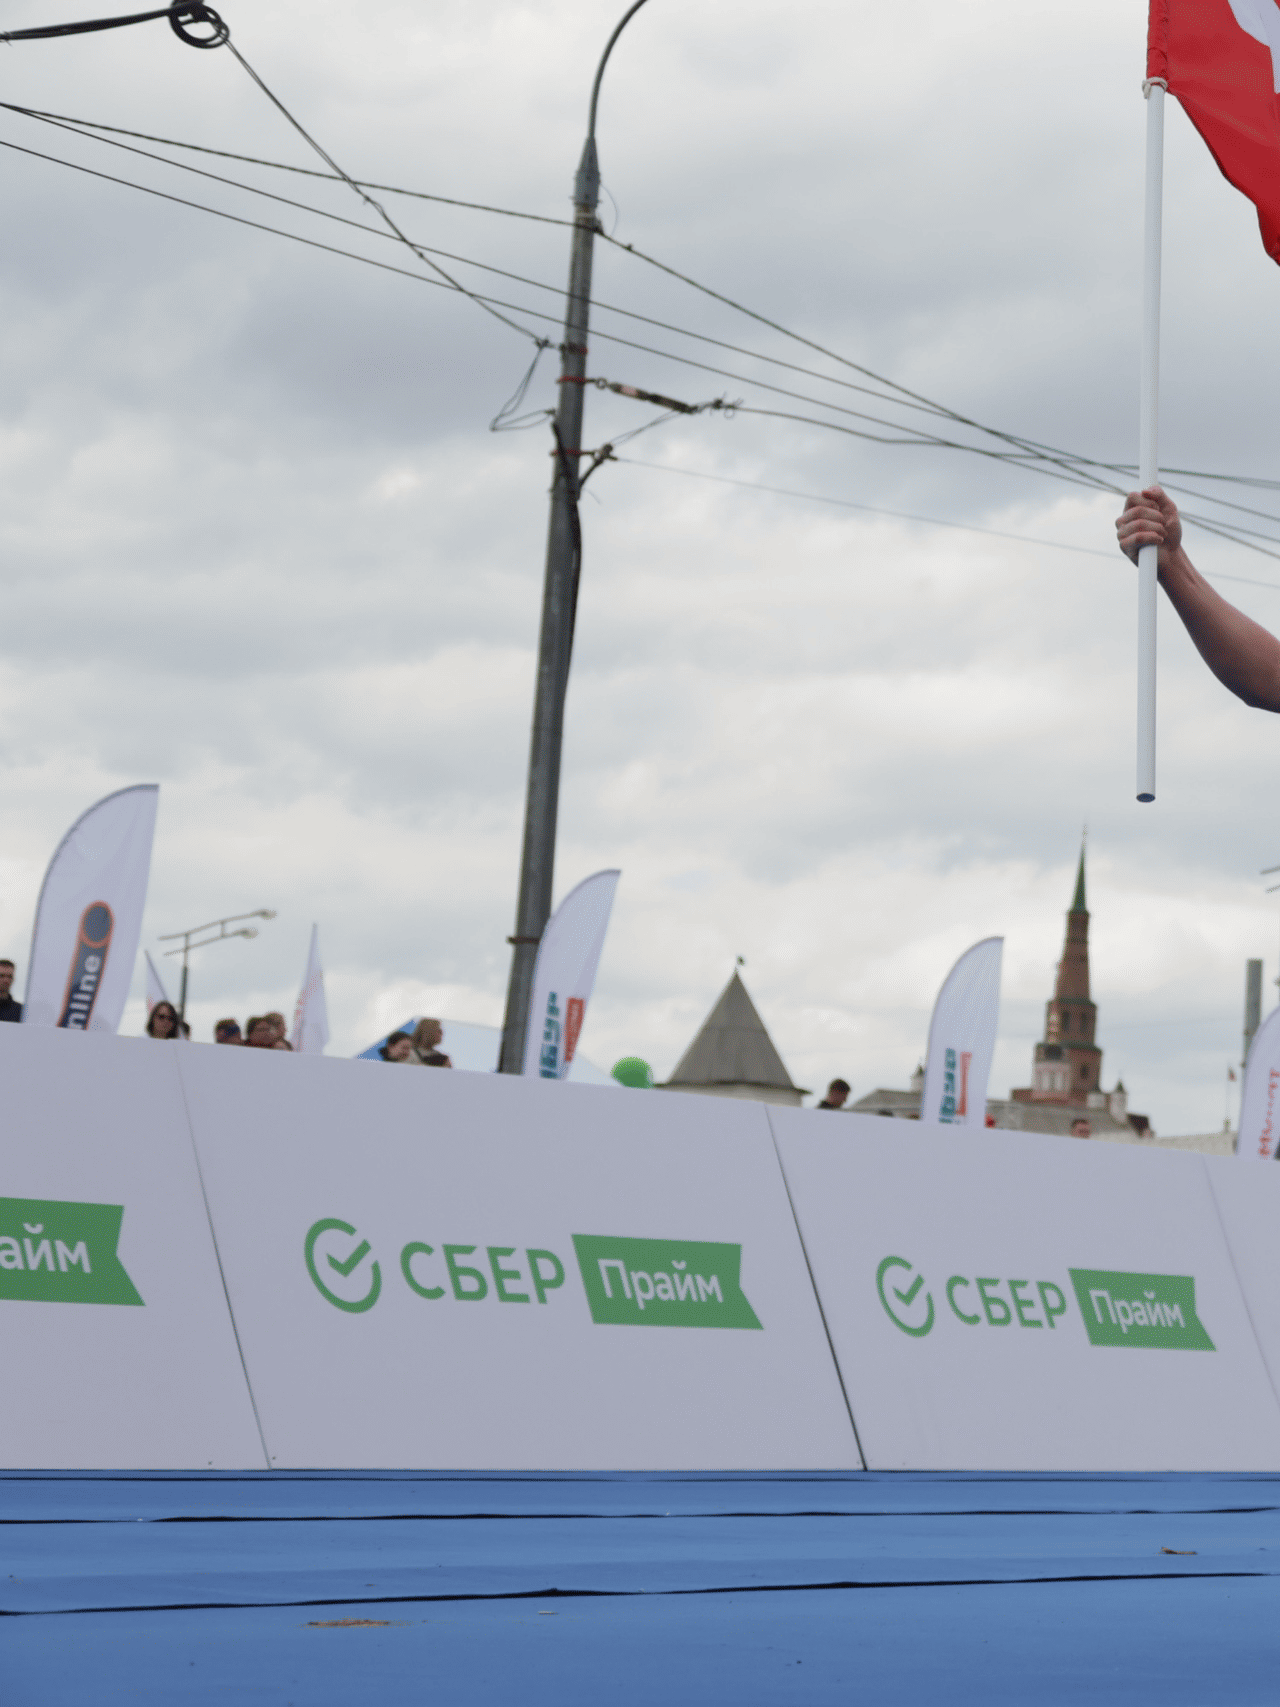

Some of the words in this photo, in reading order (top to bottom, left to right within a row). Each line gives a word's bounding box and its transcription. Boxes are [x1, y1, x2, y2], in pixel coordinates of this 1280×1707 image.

[0, 1222, 92, 1274] айм
[399, 1240, 567, 1305] СБЕР
[597, 1257, 723, 1310] Прайм
[945, 1275, 1067, 1329] СБЕР
[1088, 1289, 1186, 1334] Прайм
